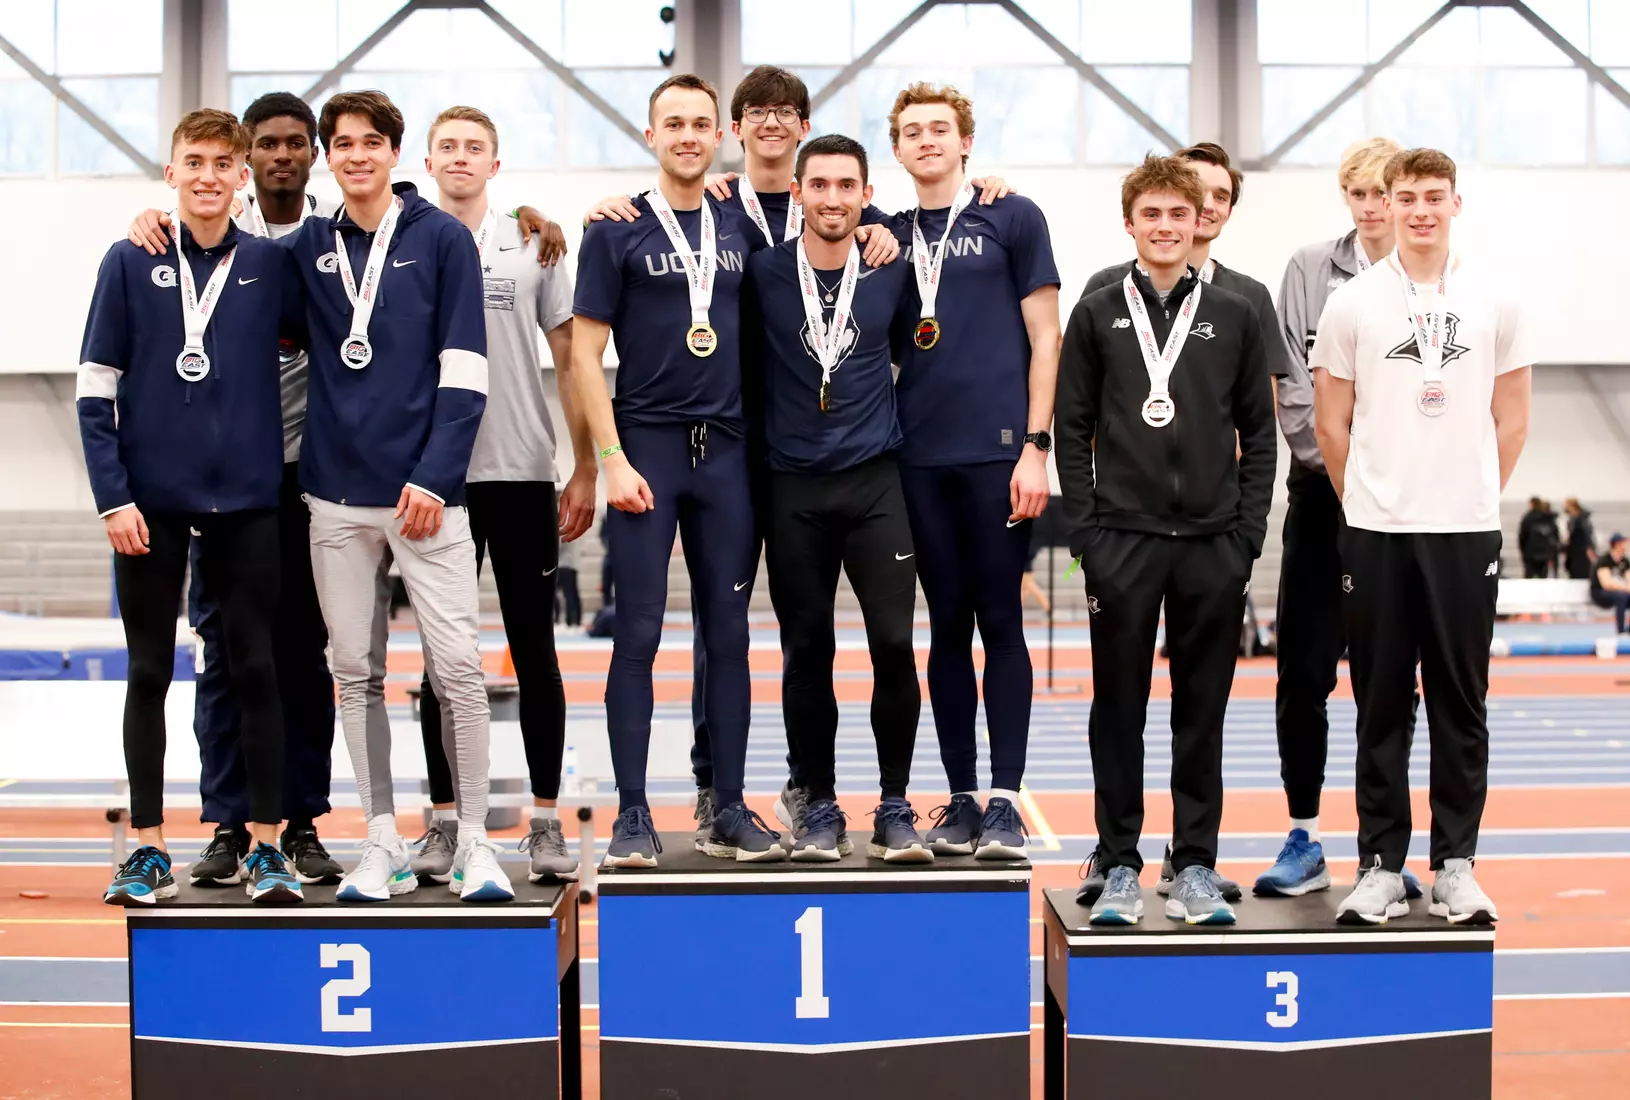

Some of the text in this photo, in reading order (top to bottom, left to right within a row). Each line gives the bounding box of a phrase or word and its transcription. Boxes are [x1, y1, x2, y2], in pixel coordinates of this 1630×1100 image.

[320, 943, 372, 1032] 2
[795, 906, 829, 1018] 1
[1266, 971, 1298, 1028] 3
